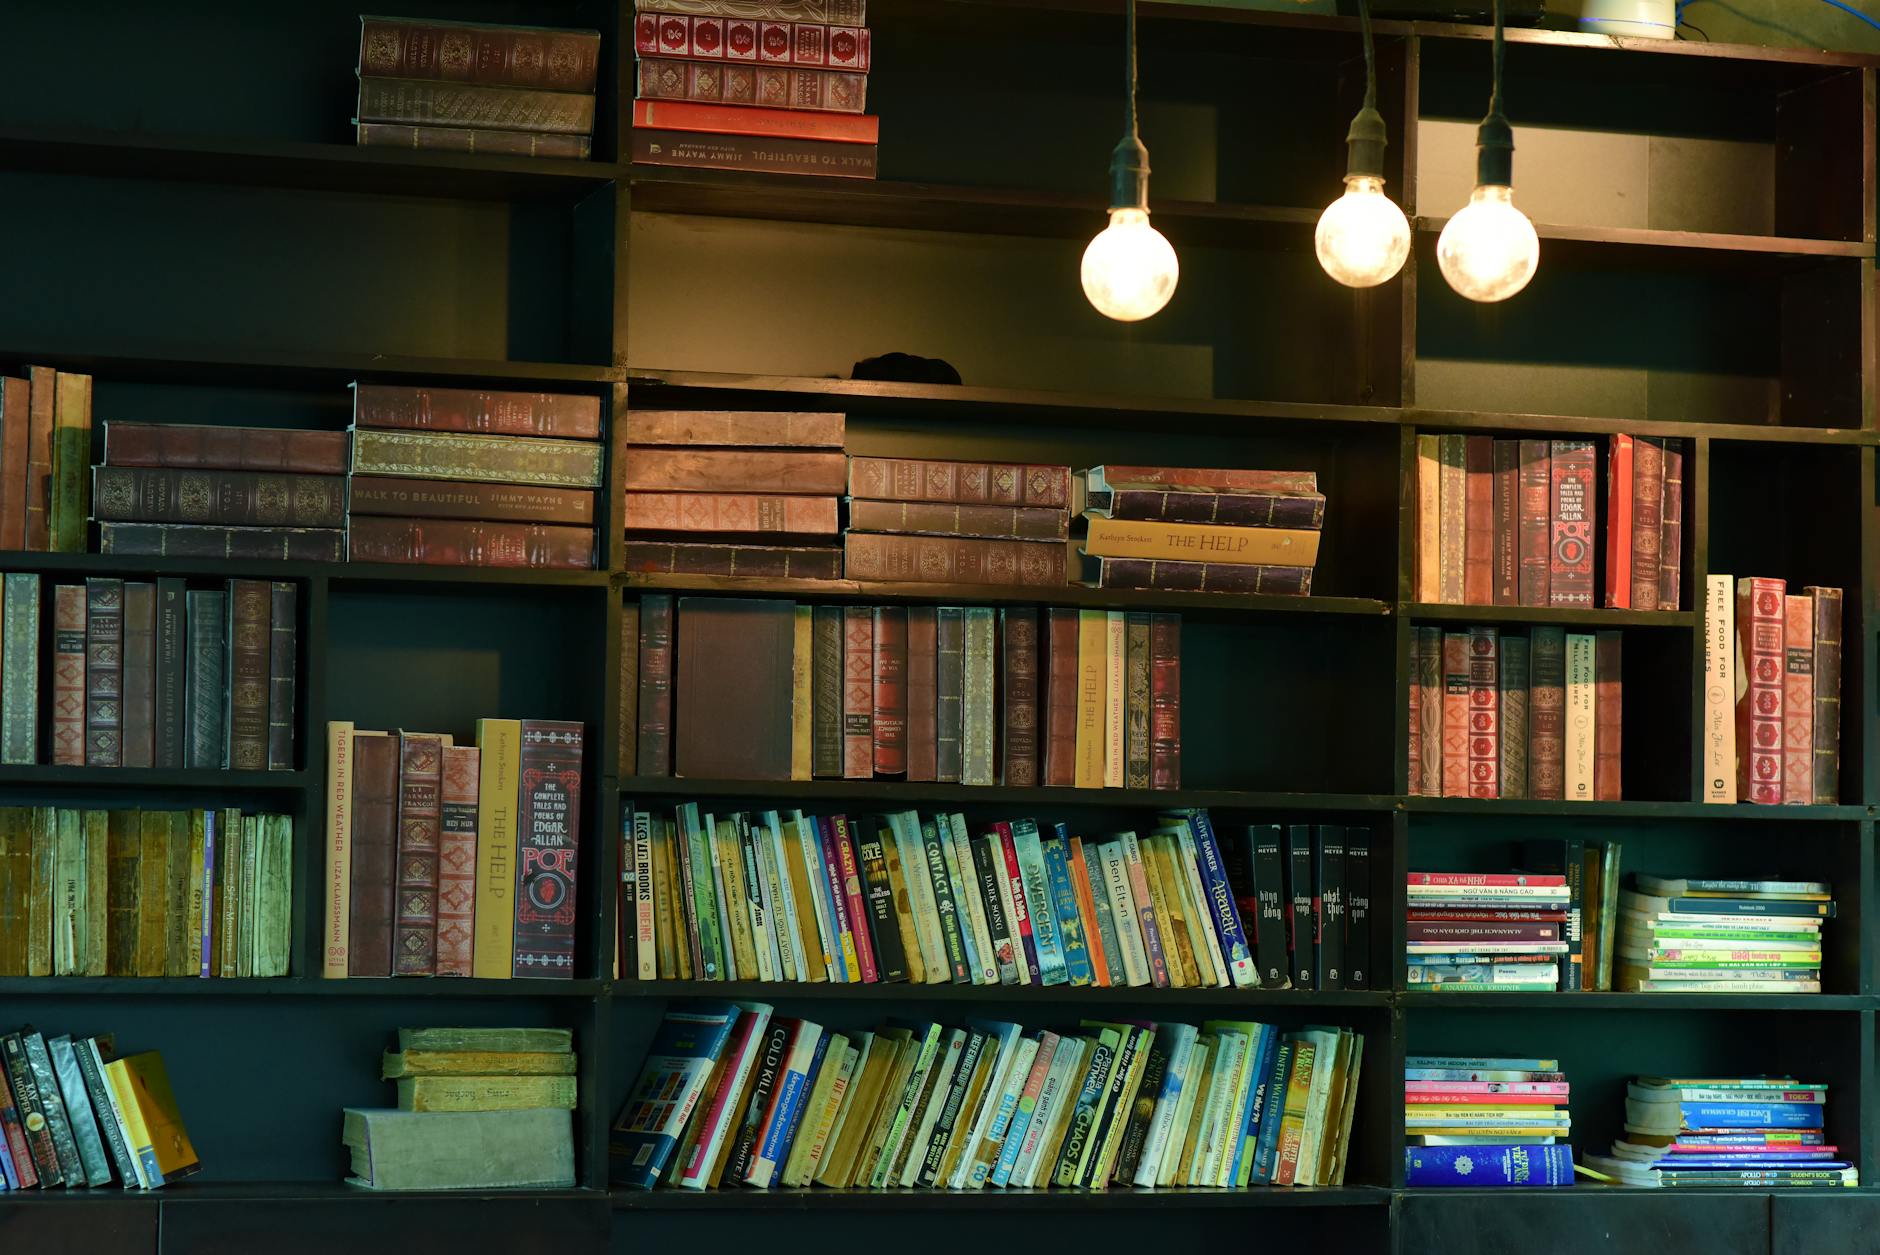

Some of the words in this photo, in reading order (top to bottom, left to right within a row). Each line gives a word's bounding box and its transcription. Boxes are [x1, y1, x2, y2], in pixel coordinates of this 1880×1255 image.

[670, 149, 706, 159] WAYNE
[710, 152, 742, 162] JIMMY
[751, 150, 816, 163] BEAUTIFUL
[820, 156, 836, 164] TO
[840, 157, 872, 168] WALK
[354, 490, 387, 500] WALK
[392, 492, 408, 501] TO
[412, 492, 480, 504] BEAUTIFUL
[490, 494, 524, 503] JIMMY
[528, 495, 562, 505] WAYNE
[1560, 504, 1585, 512] EDGAR
[1558, 512, 1582, 520] ALLAN
[1166, 534, 1194, 548] THE
[1200, 534, 1249, 553] HELP
[1552, 521, 1591, 544] POE
[1717, 581, 1725, 611] FREE
[1085, 664, 1097, 704] HELP
[1085, 706, 1094, 729] THE
[336, 730, 346, 768] TIGERS
[336, 769, 346, 782] IN
[544, 783, 556, 791] THE
[336, 782, 345, 801] RED
[534, 792, 565, 801] COMPLETE
[533, 801, 552, 810] TALES
[554, 802, 567, 810] AND
[533, 812, 554, 820] POEMS
[555, 811, 564, 820] OF
[335, 803, 344, 852] WEATHER
[494, 806, 507, 842] THE
[533, 820, 568, 834] EDGAR
[835, 819, 847, 838] BOY
[531, 834, 564, 846] ALLAN
[1195, 815, 1208, 839] CLIVE
[1202, 840, 1218, 872] BARKER
[522, 846, 576, 882] POE
[840, 840, 855, 875] CRAZY!
[862, 847, 882, 861] COLE
[334, 860, 343, 880] LIZA
[490, 844, 506, 899] HELP
[638, 862, 650, 900] BROOKS
[926, 841, 949, 896] CONTACT
[1109, 859, 1123, 883] Ben
[984, 874, 998, 902] DARK
[333, 881, 342, 944] KLAUSSMANN
[945, 914, 957, 932] Chris
[990, 904, 1004, 931] SONG
[1024, 862, 1058, 958] DIVERGENT
[639, 911, 651, 942] BEING
[764, 1028, 787, 1068] COLD
[960, 1034, 983, 1075] DEFENDER
[1084, 1045, 1109, 1096] Cornwell
[1095, 1056, 1112, 1090] Patricia
[1274, 1045, 1290, 1081] MINETTE
[1293, 1047, 1307, 1083] STRONG
[1301, 1046, 1315, 1087] TERENCE
[14, 1076, 32, 1114] HOOPER
[25, 1082, 38, 1102] KAY
[756, 1068, 775, 1096] KILL
[831, 1077, 847, 1096] THE
[1267, 1082, 1283, 1118] WALTERS
[94, 1088, 111, 1122] MICHAEL
[107, 1123, 126, 1162] ONDAATJE
[1737, 1109, 1772, 1123] ENGLISH
[1066, 1111, 1090, 1159] CHAOS
[1282, 1127, 1294, 1162] HOSTAGE
[734, 1140, 750, 1172] WHITE
[1289, 1144, 1299, 1164] FIFTH
